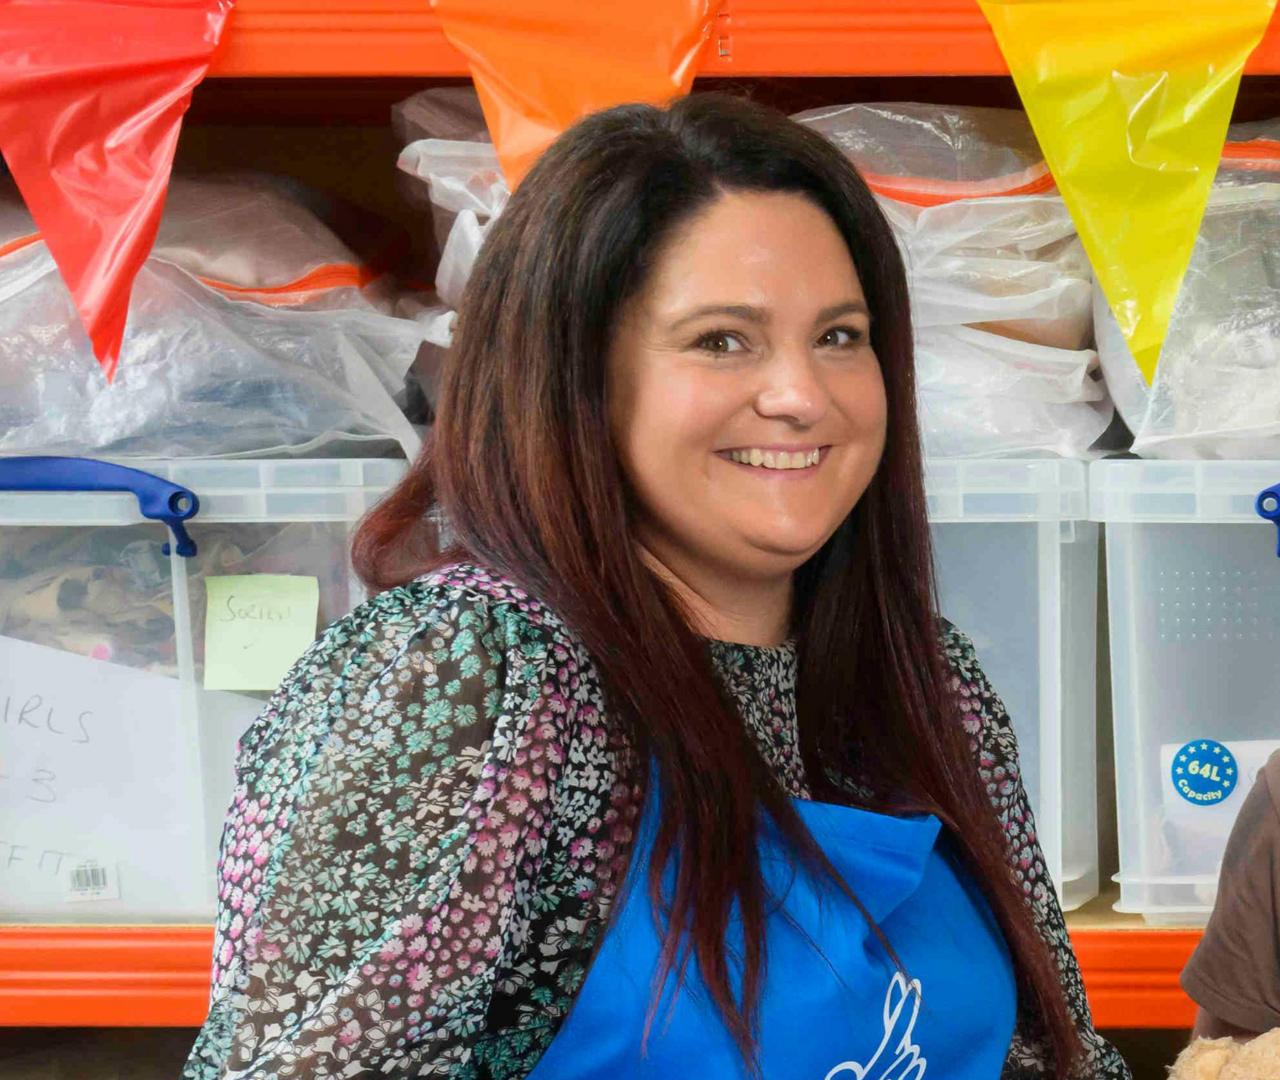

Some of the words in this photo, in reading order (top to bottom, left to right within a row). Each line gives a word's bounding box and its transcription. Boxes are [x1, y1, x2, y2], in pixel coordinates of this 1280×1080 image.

[3, 694, 93, 744] IRLS
[1188, 760, 1221, 782] 64L
[1178, 779, 1222, 801] Capacity
